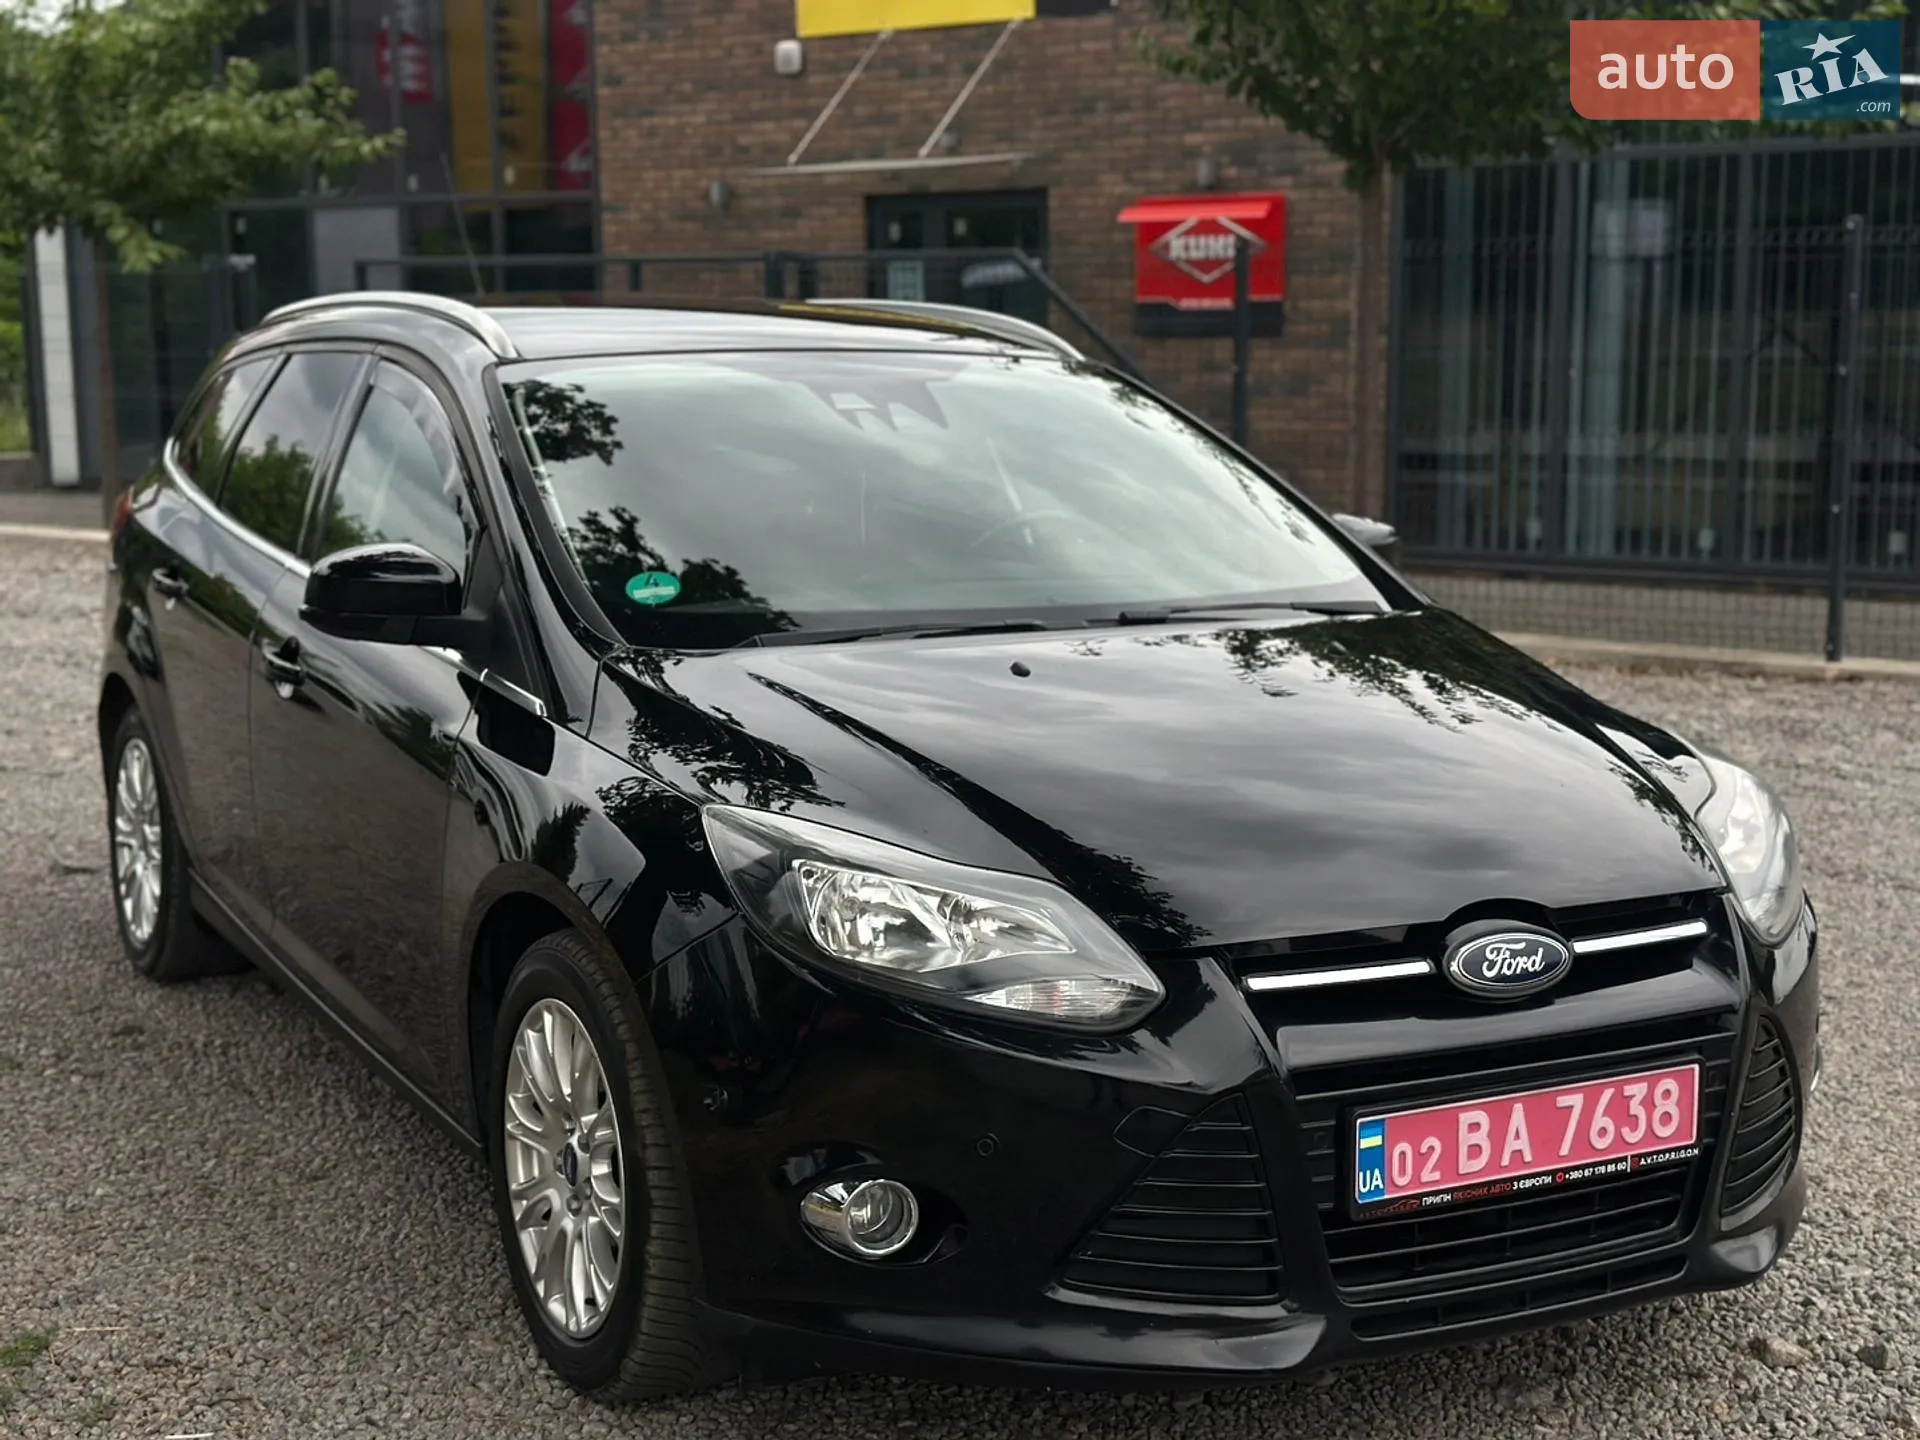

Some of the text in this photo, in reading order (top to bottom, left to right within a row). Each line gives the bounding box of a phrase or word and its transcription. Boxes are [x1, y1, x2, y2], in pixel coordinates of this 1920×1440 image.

[1482, 941, 1546, 978] Ford
[1391, 1078, 1680, 1187] 02 BA 7638
[1358, 1168, 1384, 1193] UA
